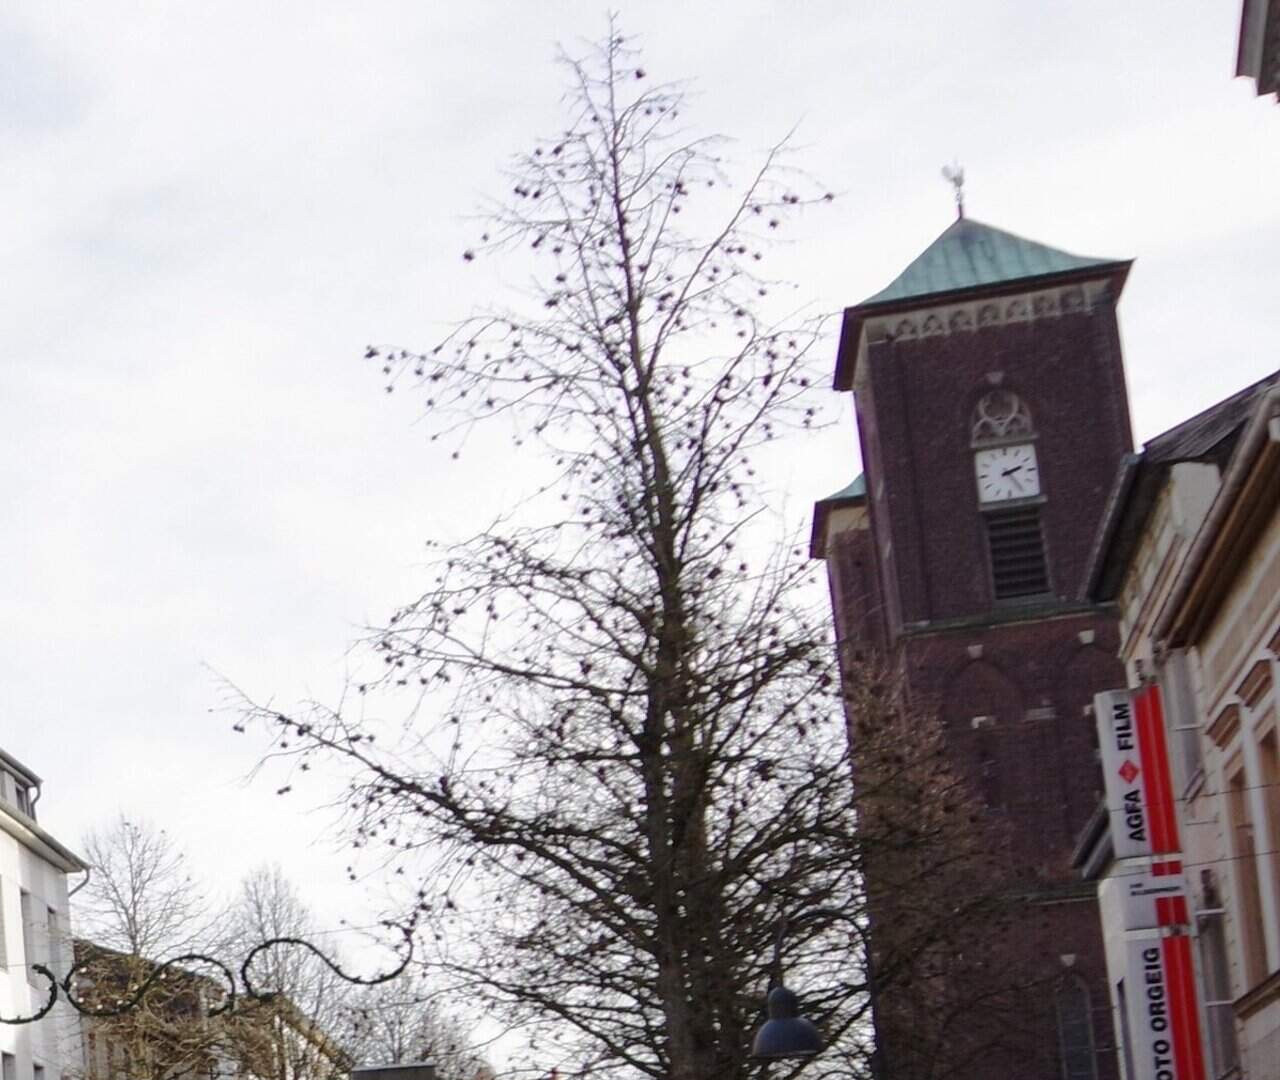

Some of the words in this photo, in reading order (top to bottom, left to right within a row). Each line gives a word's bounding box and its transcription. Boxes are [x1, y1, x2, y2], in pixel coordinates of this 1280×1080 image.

[1113, 703, 1134, 751] FILM
[1124, 789, 1146, 842] AGFA
[1142, 947, 1169, 1033] ORGEIG
